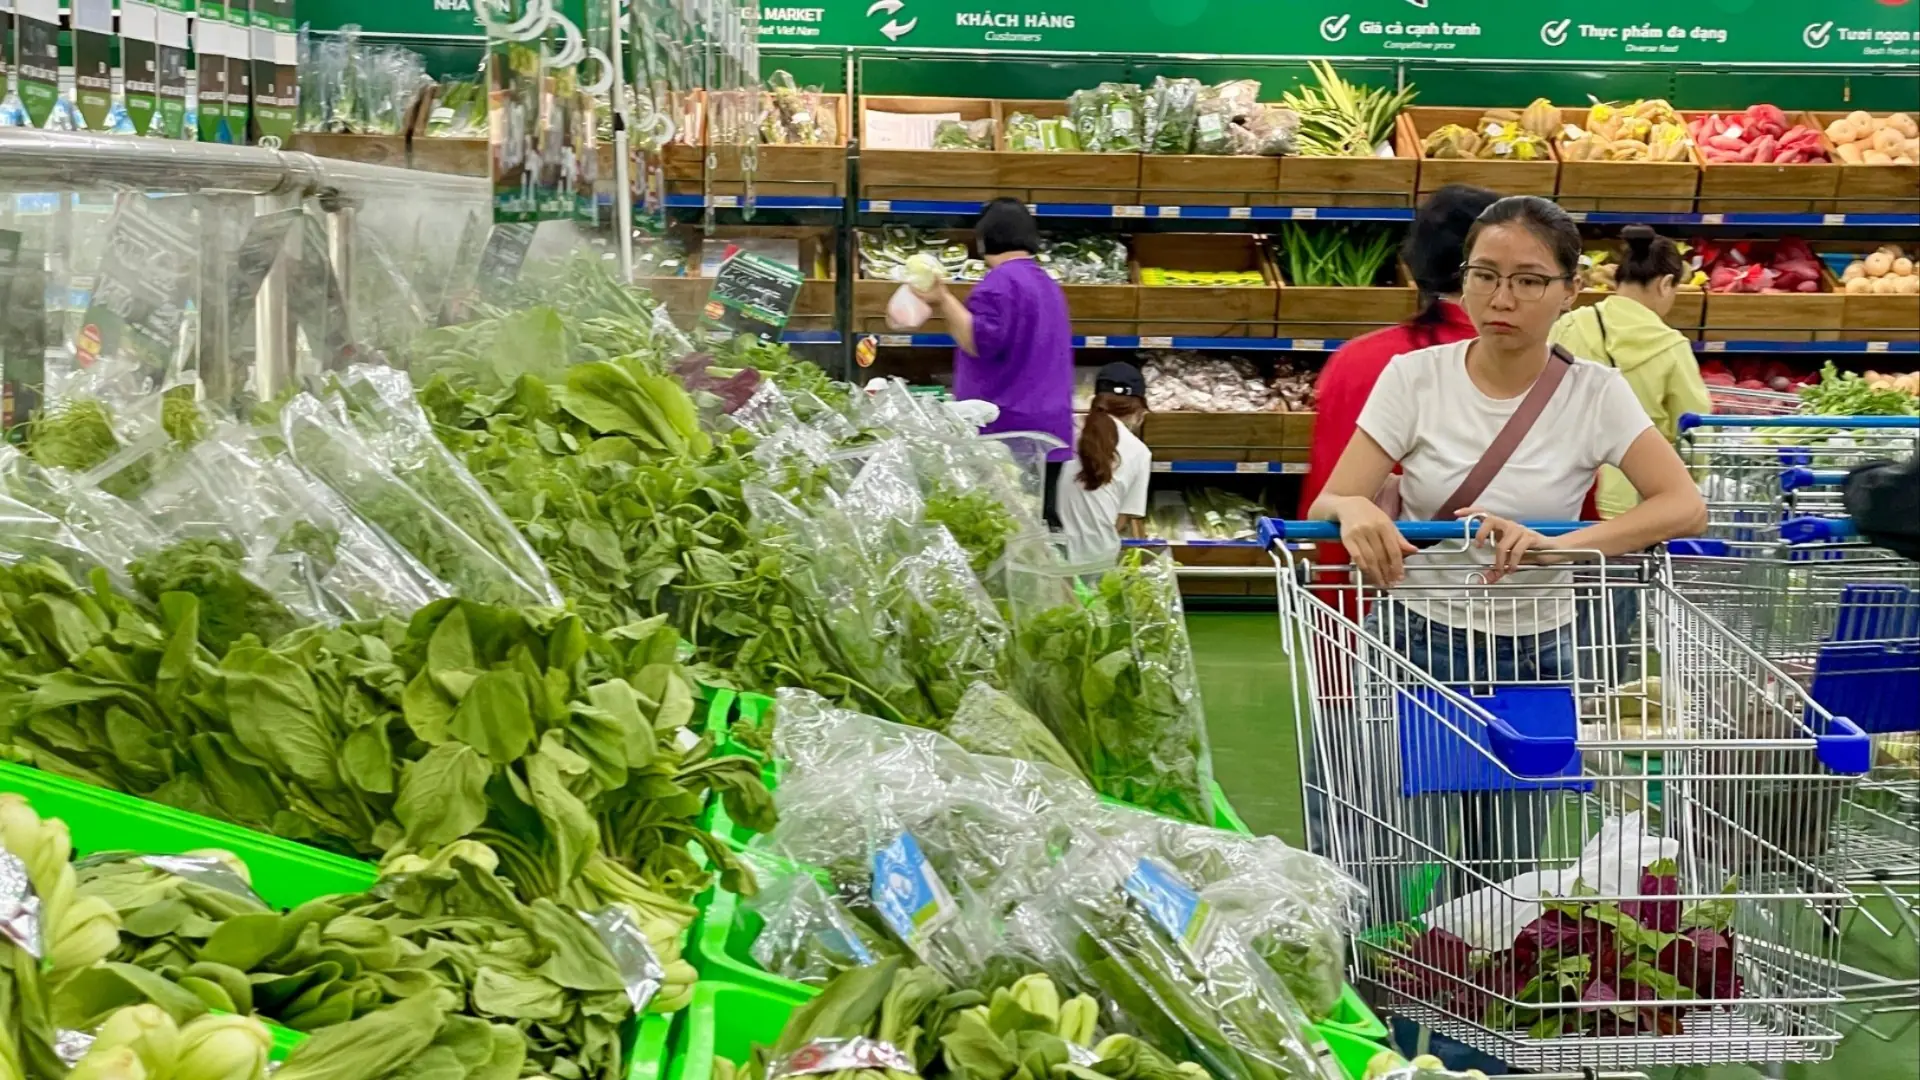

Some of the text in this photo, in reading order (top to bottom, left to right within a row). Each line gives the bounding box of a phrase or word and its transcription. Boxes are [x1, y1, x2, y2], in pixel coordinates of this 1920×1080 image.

[764, 7, 825, 21] MARKET
[956, 10, 1076, 28] KHÁCH HÀNG
[985, 31, 1042, 41] Customers
[1359, 21, 1383, 34] Giá
[1405, 22, 1440, 38] cạnh
[1442, 22, 1482, 35] tranh
[1578, 24, 1618, 40] Thực
[1667, 26, 1687, 38] đa
[1690, 26, 1728, 43] dạng
[1874, 31, 1910, 44] ngon
